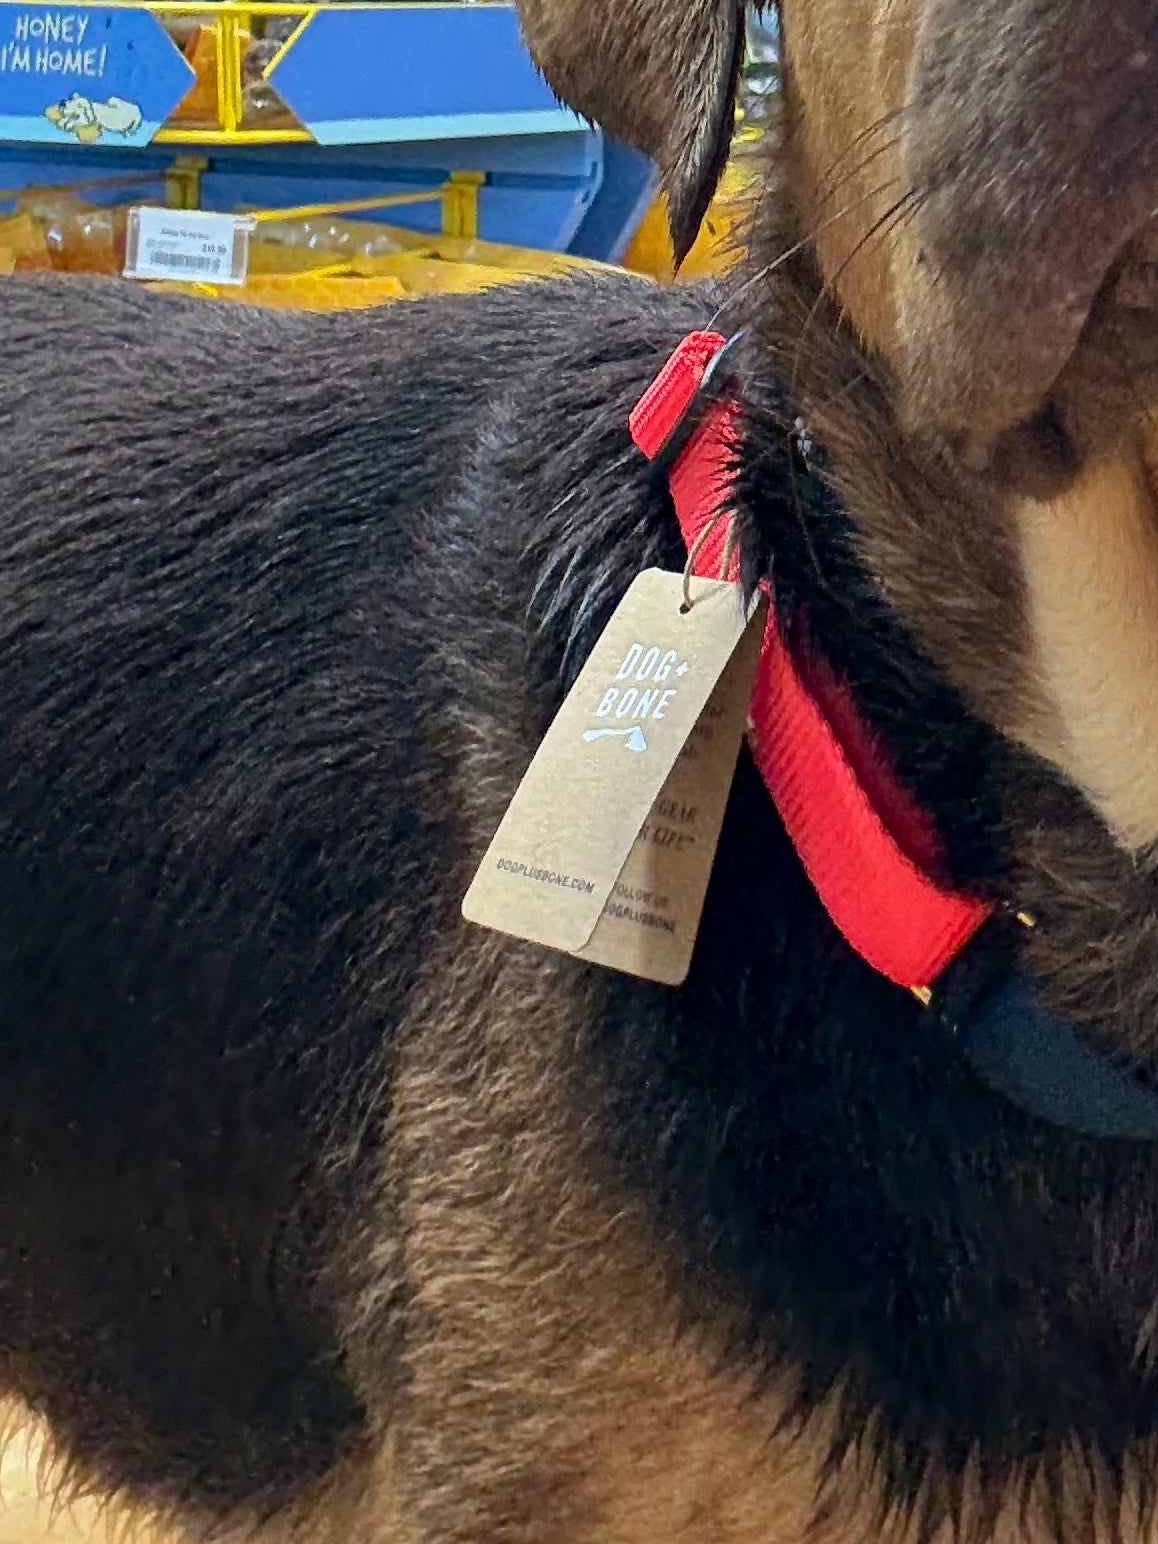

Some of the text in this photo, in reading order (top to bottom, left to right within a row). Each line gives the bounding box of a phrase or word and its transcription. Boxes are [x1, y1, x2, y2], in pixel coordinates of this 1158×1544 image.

[15, 10, 89, 44] HONEY
[1, 40, 107, 77] I'M HOME!
[594, 686, 677, 718] BONE
[496, 857, 595, 894] DOGPLUSBONE.COM
